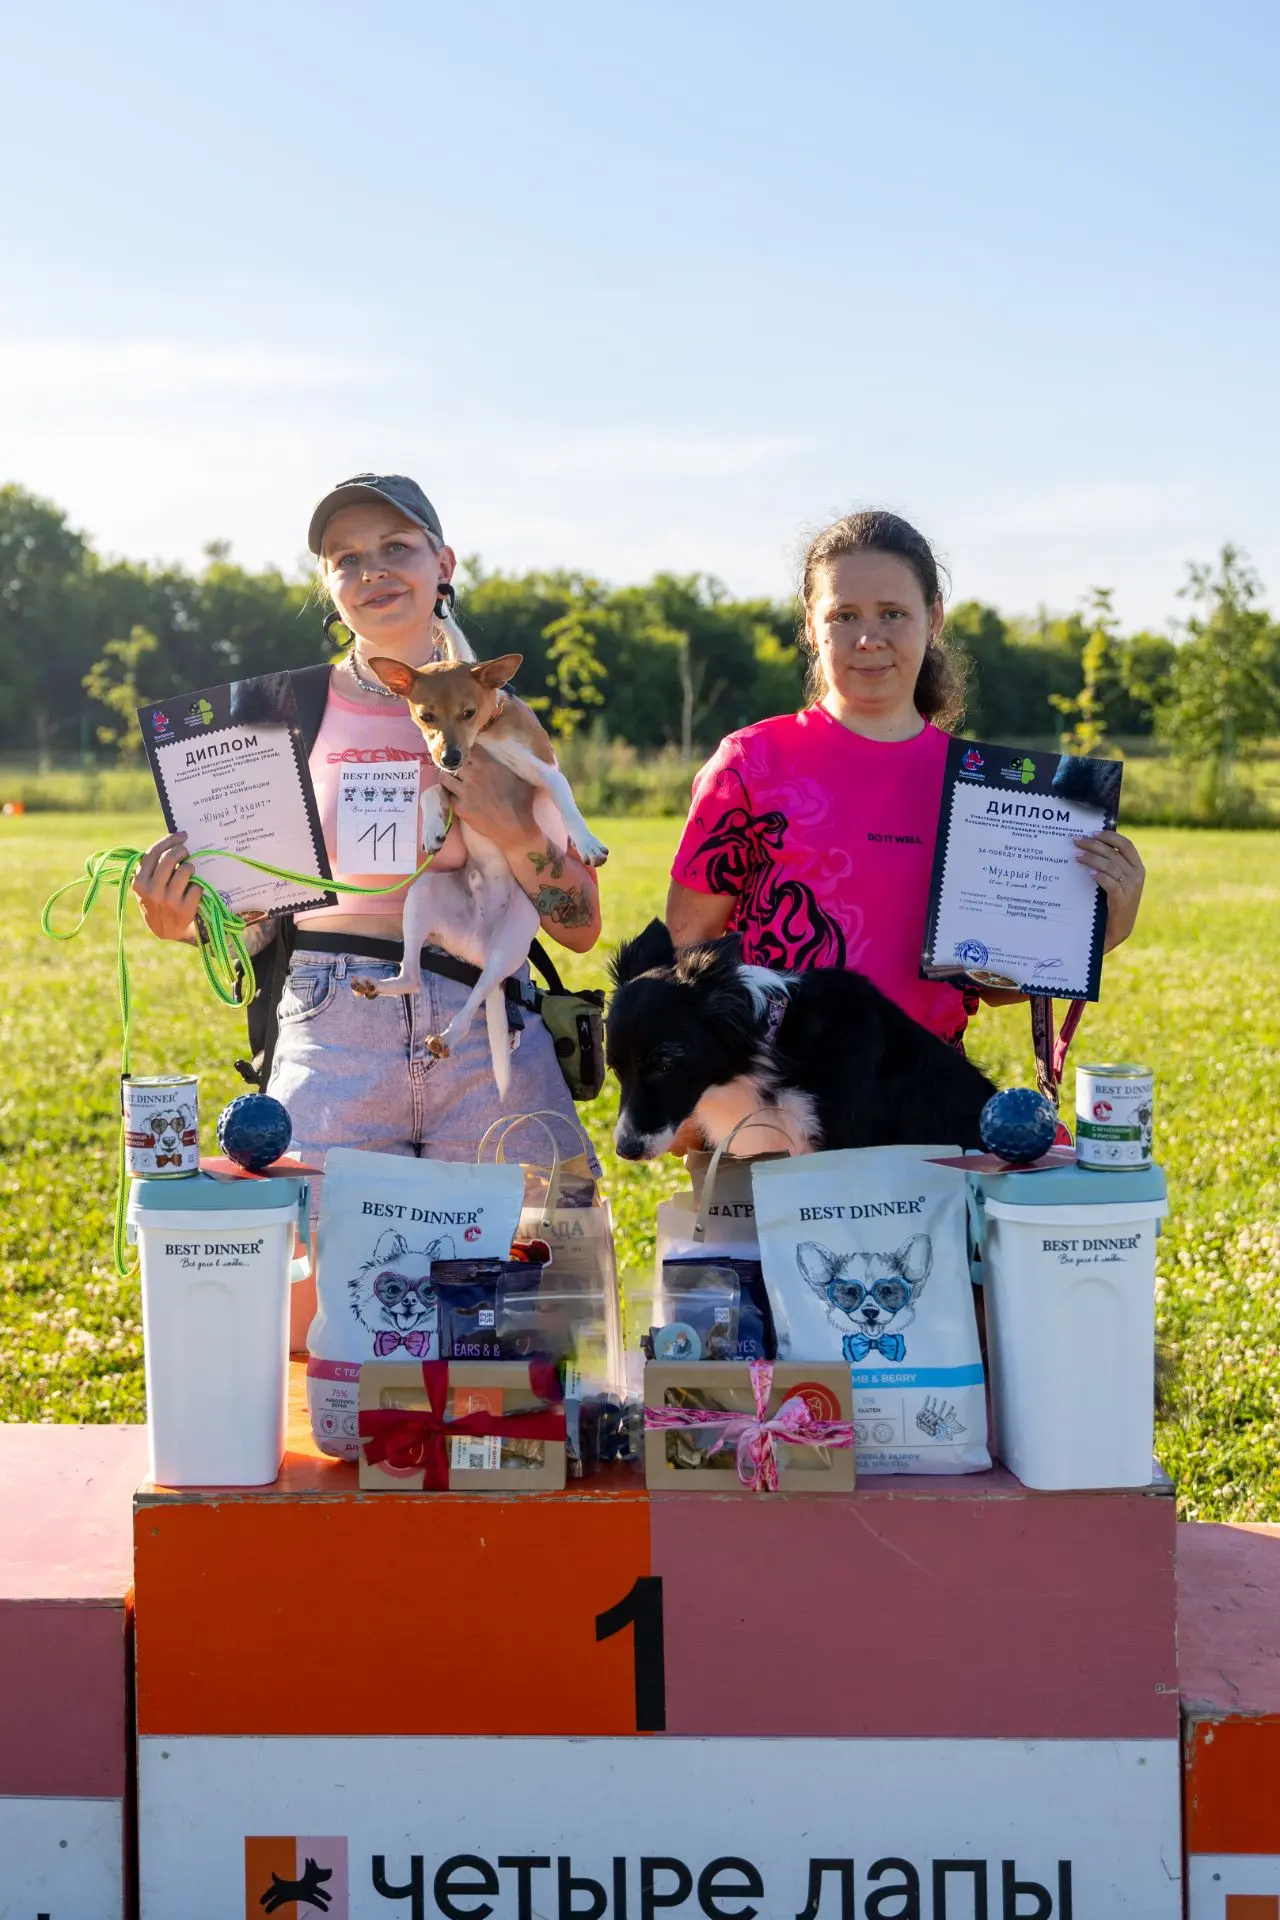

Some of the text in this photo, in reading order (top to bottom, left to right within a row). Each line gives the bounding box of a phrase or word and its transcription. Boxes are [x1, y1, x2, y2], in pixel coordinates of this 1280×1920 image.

[185, 735, 258, 767] ДИПЛОМ
[343, 771, 416, 781] BEST DINNER
[986, 800, 1070, 823] ДИПЛОМ
[357, 822, 396, 862] 11
[1004, 845, 1043, 855] ВРУЧАЕТСЯ
[988, 849, 1016, 859] ПОБЕДУ
[1024, 854, 1069, 865] НОМИНАЦИИ
[1095, 1085, 1122, 1094] BEST
[137, 1094, 176, 1104] DINNER
[361, 1201, 478, 1225] BEST DINNER
[799, 1201, 922, 1221] BEST DINNER
[165, 1243, 261, 1255] BEST DINNER
[1042, 1238, 1138, 1251] BEST DINNER
[454, 1343, 480, 1357] EARS
[483, 1344, 490, 1357] &
[334, 1367, 341, 1376] С
[871, 1375, 879, 1384] &
[881, 1374, 917, 1383] BERRY
[331, 1389, 348, 1399] 75%
[595, 1576, 666, 1732] 1
[372, 1854, 1072, 1920] четыре лапы
